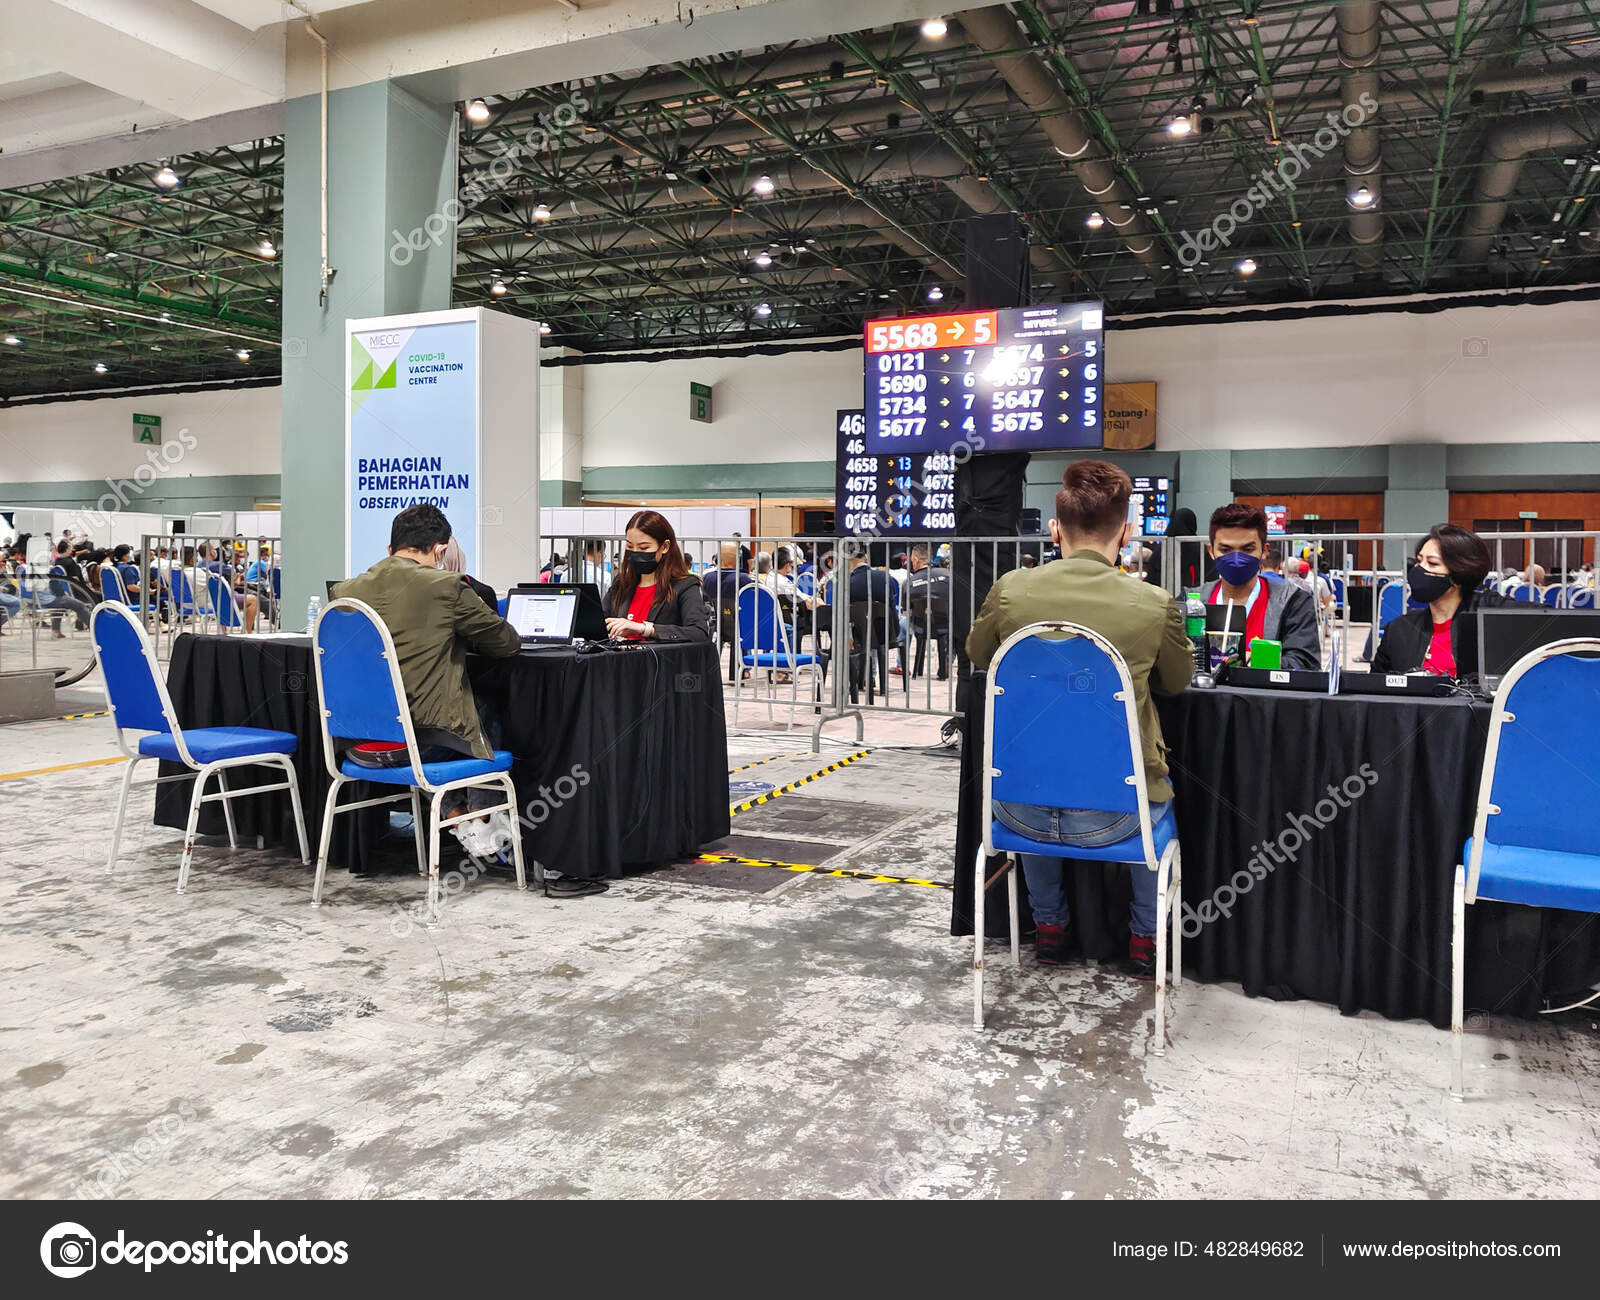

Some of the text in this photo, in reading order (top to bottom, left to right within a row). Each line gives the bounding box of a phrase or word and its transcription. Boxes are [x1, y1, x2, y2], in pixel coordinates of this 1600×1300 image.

[370, 334, 400, 346] MIECC
[873, 318, 991, 351] 5568 5
[408, 352, 445, 362] COVID-19
[1084, 340, 1097, 358] 5
[408, 363, 463, 374] VACCINATION
[879, 349, 976, 373] 0121 7
[1083, 363, 1098, 381] 6
[408, 376, 438, 386] CENTRE
[879, 371, 976, 395] 5690 6
[879, 394, 976, 416] 5734 7
[992, 386, 1097, 410] 5647 5
[697, 399, 706, 419] B
[1109, 409, 1143, 419] Datang
[879, 415, 976, 438] 5677 4
[991, 411, 1044, 433] 5675
[1083, 409, 1097, 427] 5
[140, 427, 154, 442] A
[358, 456, 442, 473] BAHAGIAN
[846, 458, 878, 473] 4658
[898, 456, 912, 471] 13
[358, 474, 469, 491] PEMERHATIAN
[845, 476, 878, 492] 4675
[898, 476, 912, 489] 14
[845, 495, 878, 510] 4674
[898, 494, 912, 509] 14
[1156, 493, 1166, 503] 14
[1156, 504, 1166, 514] 14
[897, 513, 912, 528] 14
[922, 512, 956, 529] 4600
